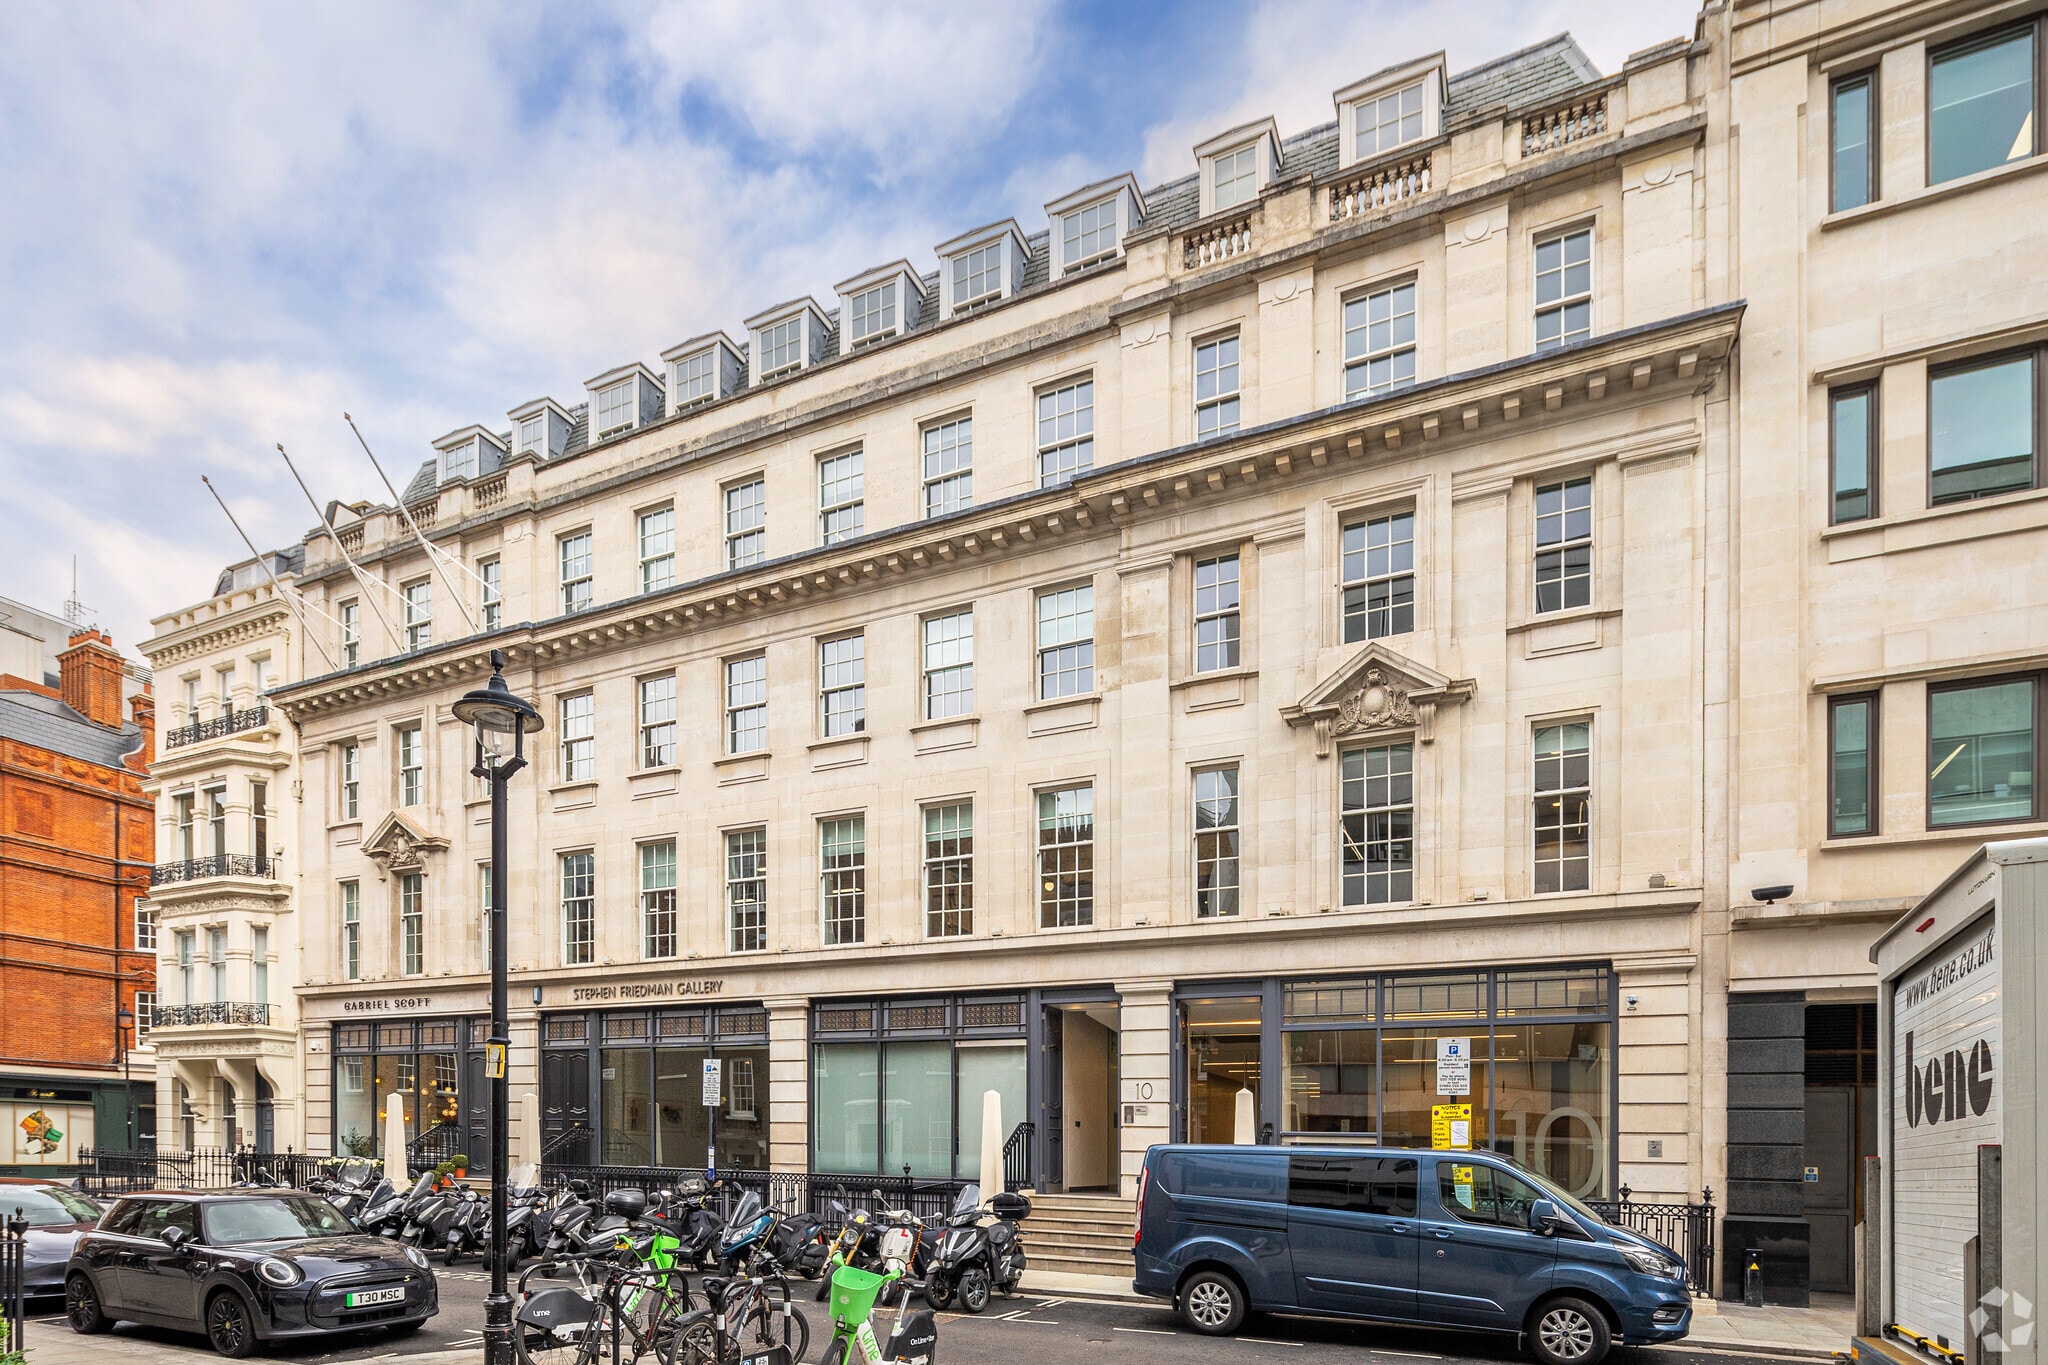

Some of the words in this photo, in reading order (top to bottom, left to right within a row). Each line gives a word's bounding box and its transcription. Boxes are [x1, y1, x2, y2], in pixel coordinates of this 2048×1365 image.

[1906, 928, 1995, 1009] www.bene.co.uk
[573, 987, 616, 1000] STEPHEN
[620, 983, 673, 998] FRIEDMAN
[677, 980, 723, 995] GALLERY
[344, 1000, 390, 1011] GABRIEL
[394, 997, 431, 1009] SCOTT
[1136, 1082, 1153, 1100] 10
[1906, 1030, 1993, 1129] bene
[1502, 1106, 1604, 1199] 10
[358, 1292, 378, 1303] T30
[381, 1290, 400, 1300] MSC
[862, 1327, 880, 1362] Lime
